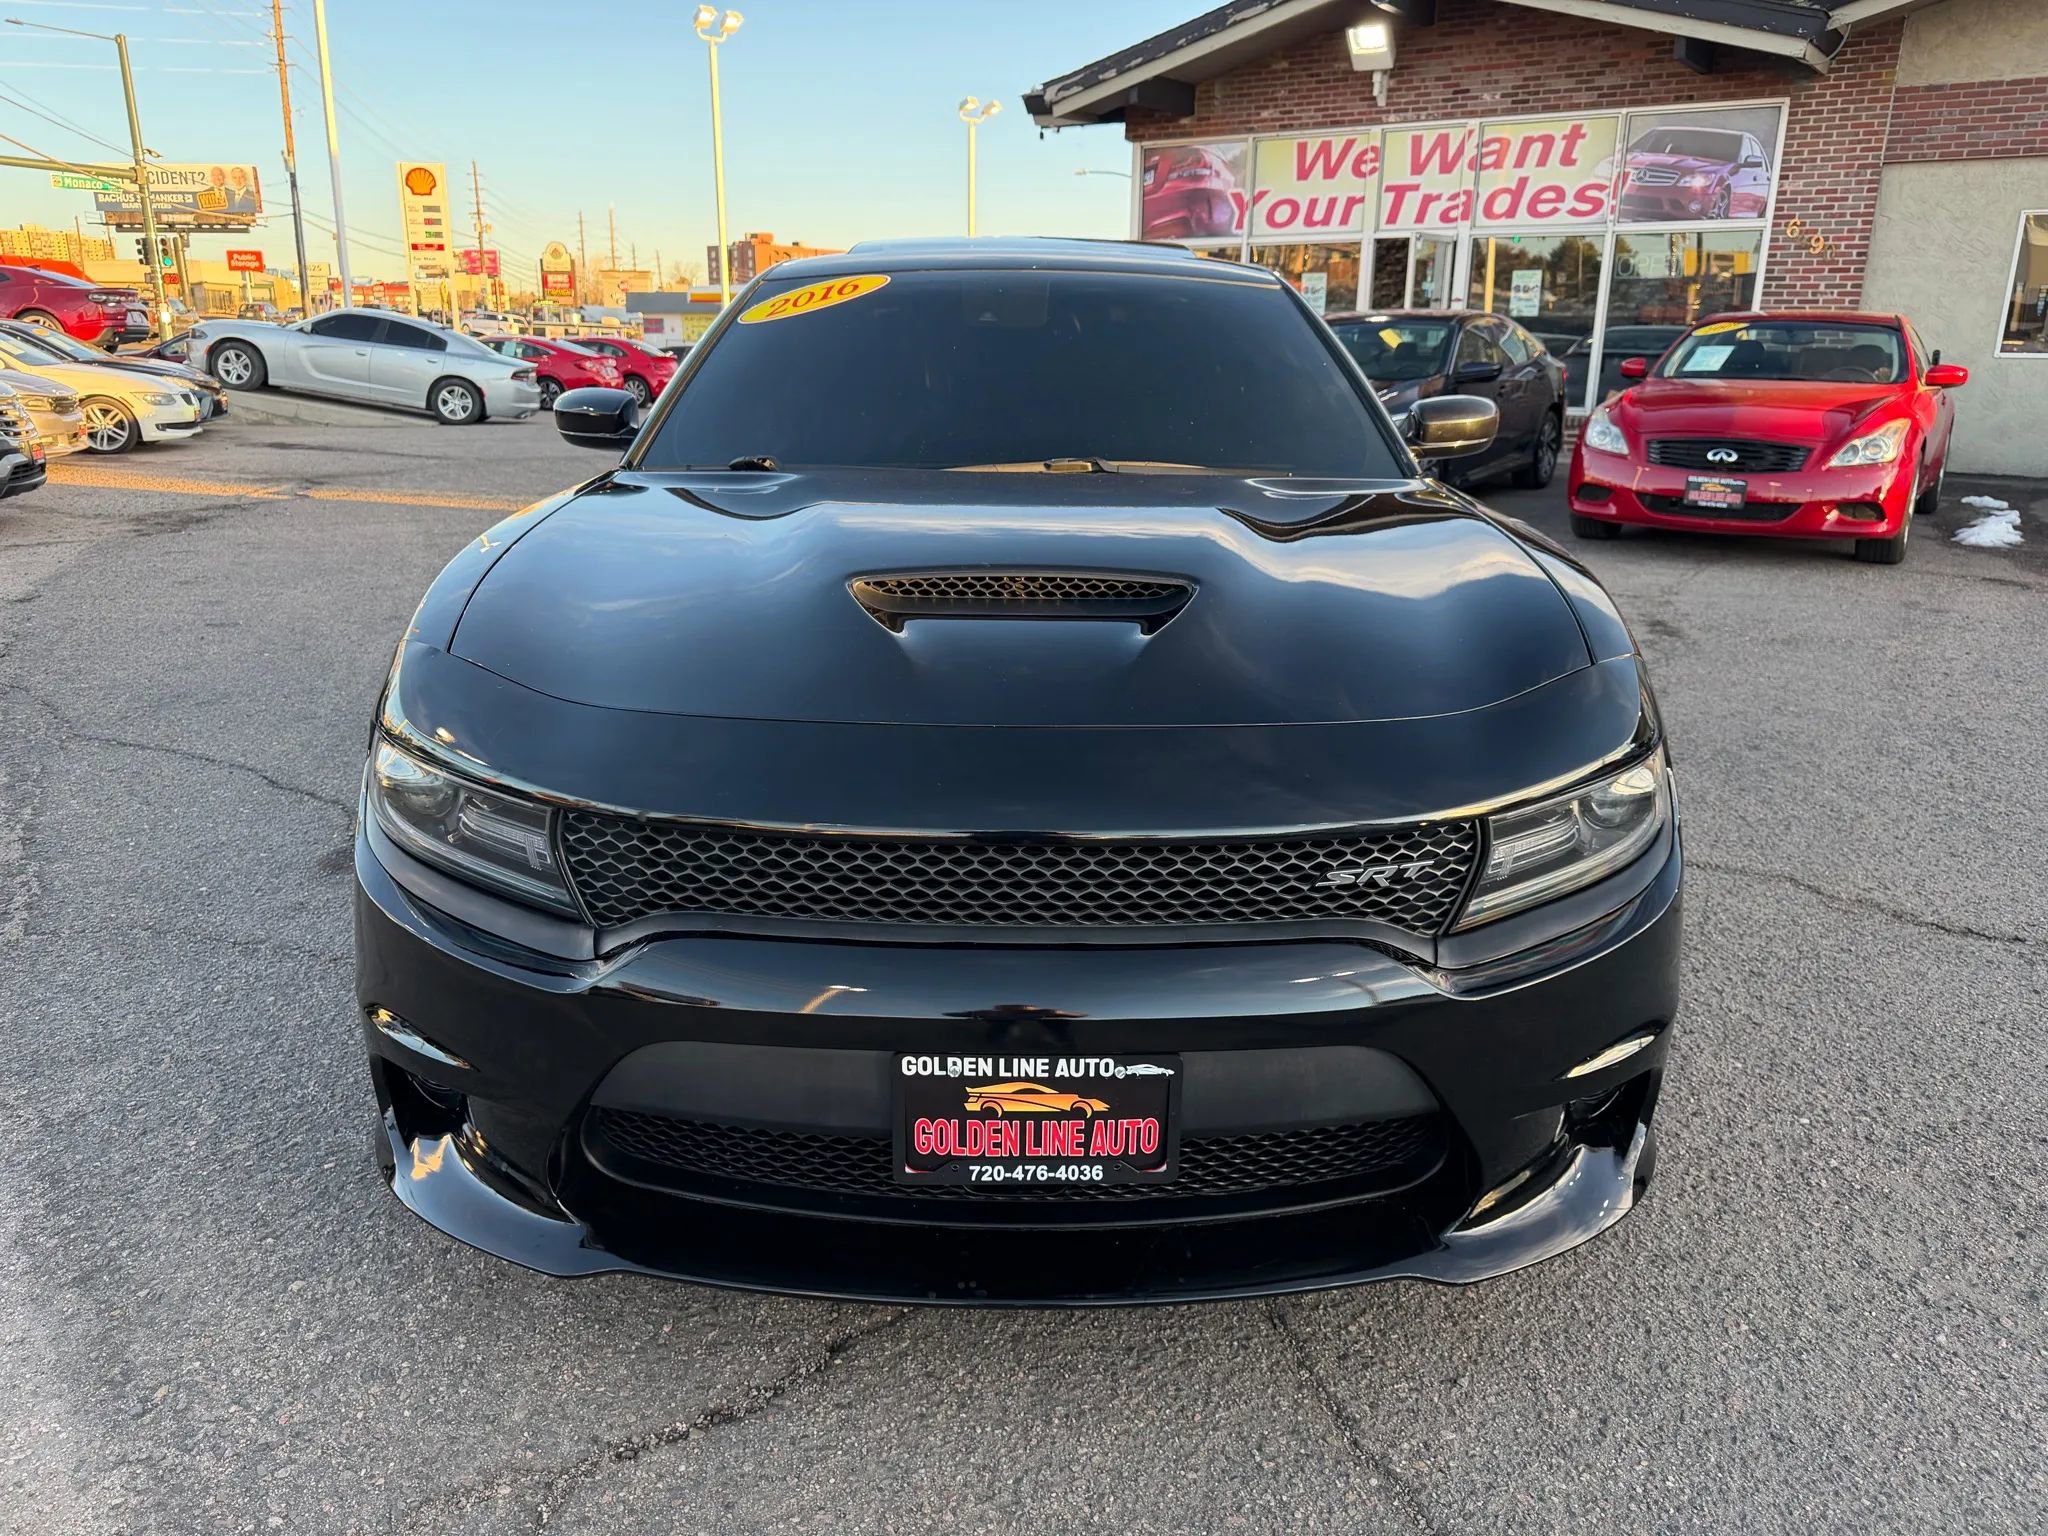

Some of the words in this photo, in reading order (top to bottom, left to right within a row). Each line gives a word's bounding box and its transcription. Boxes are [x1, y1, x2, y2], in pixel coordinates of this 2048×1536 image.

[1296, 136, 1381, 182] We
[1409, 123, 1587, 176] Want
[64, 177, 103, 190] Monaco
[1230, 189, 1366, 231] Your
[1383, 172, 1631, 226] Trades!
[230, 259, 260, 269] Storage
[233, 253, 256, 262] Public
[766, 277, 863, 319] 2016
[1315, 860, 1435, 887] SRT
[901, 1055, 993, 1078] GOLDEN
[998, 1057, 1050, 1078] LINE
[1054, 1057, 1116, 1078] AUTO
[914, 1117, 1020, 1157] GOLDEN
[1025, 1119, 1085, 1157] LINE
[1090, 1117, 1160, 1157] AUTO
[968, 1164, 1104, 1182] 720-476-4036
